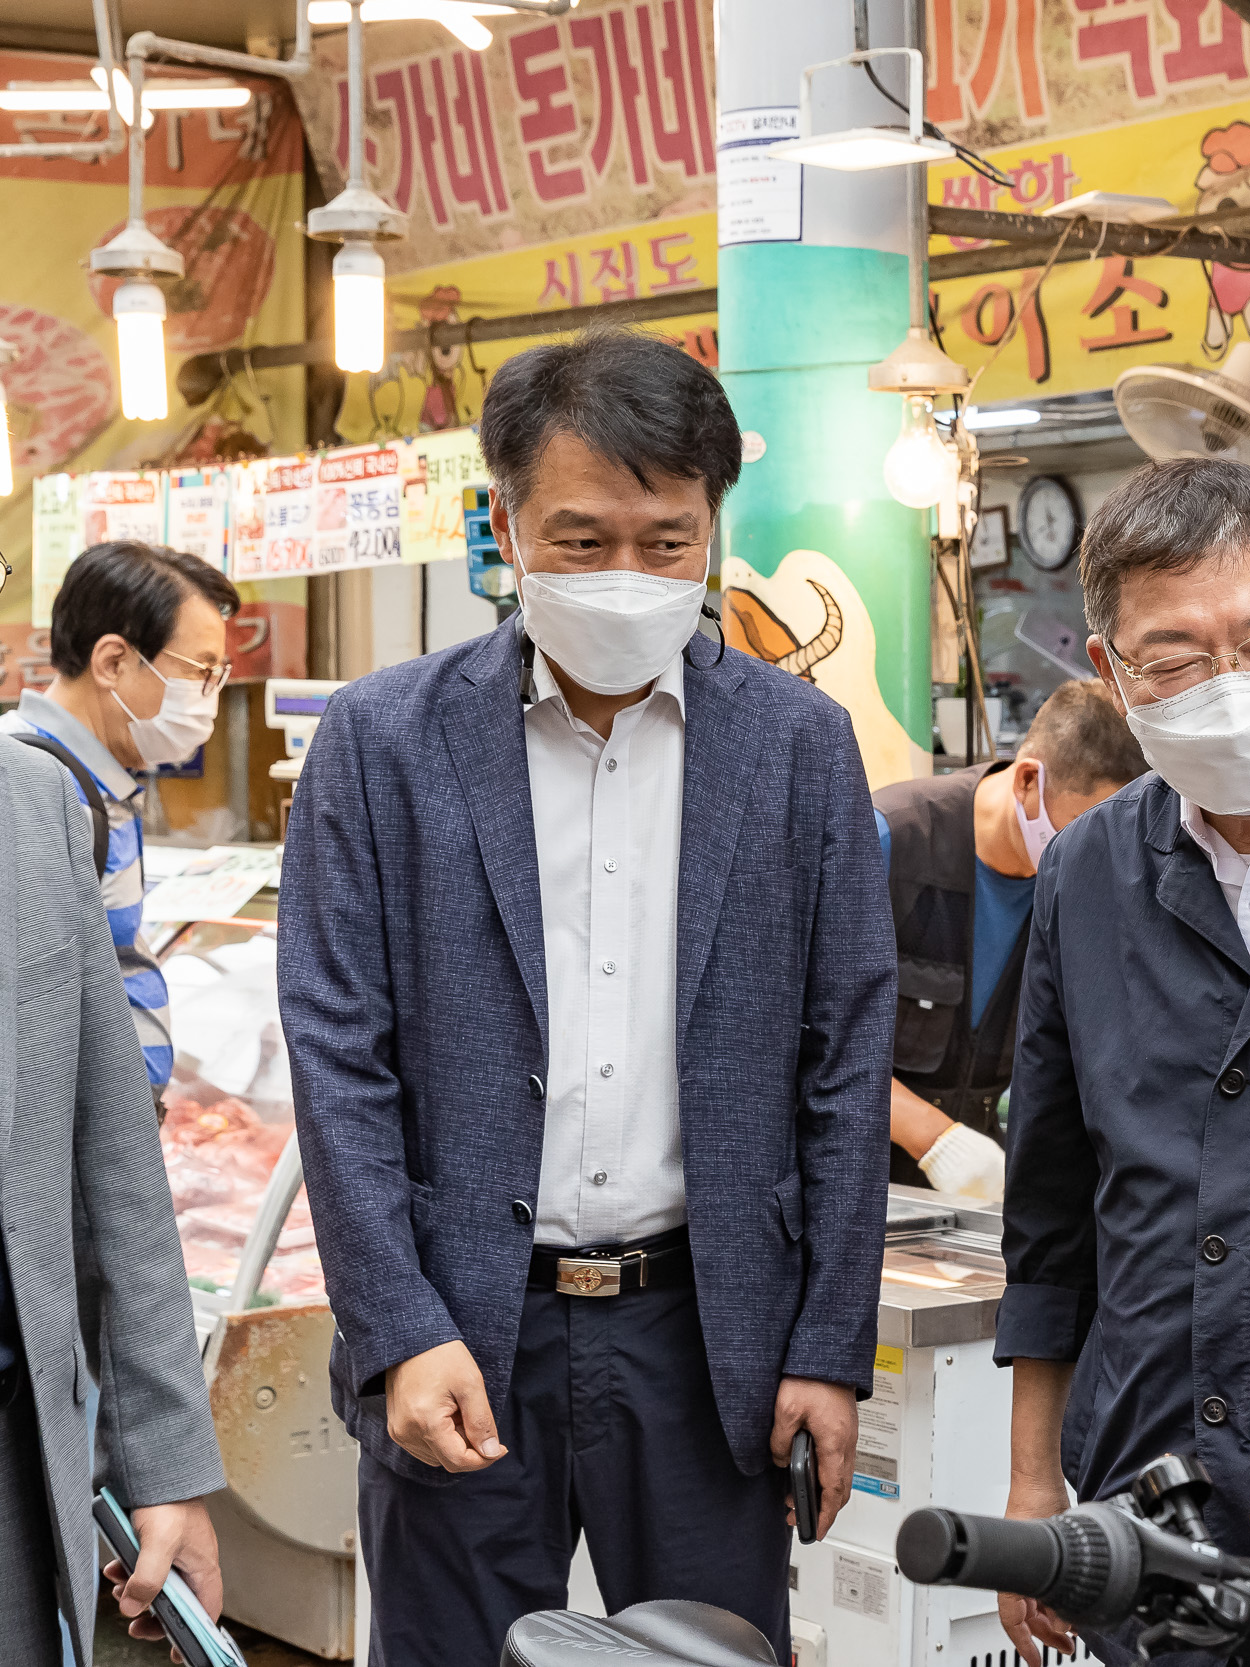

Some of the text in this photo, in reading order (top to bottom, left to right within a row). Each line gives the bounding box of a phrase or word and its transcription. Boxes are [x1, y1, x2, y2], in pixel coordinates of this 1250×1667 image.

[510, 0, 716, 199] 돈가네
[538, 232, 702, 307] 시집도
[929, 255, 1173, 384] 이소
